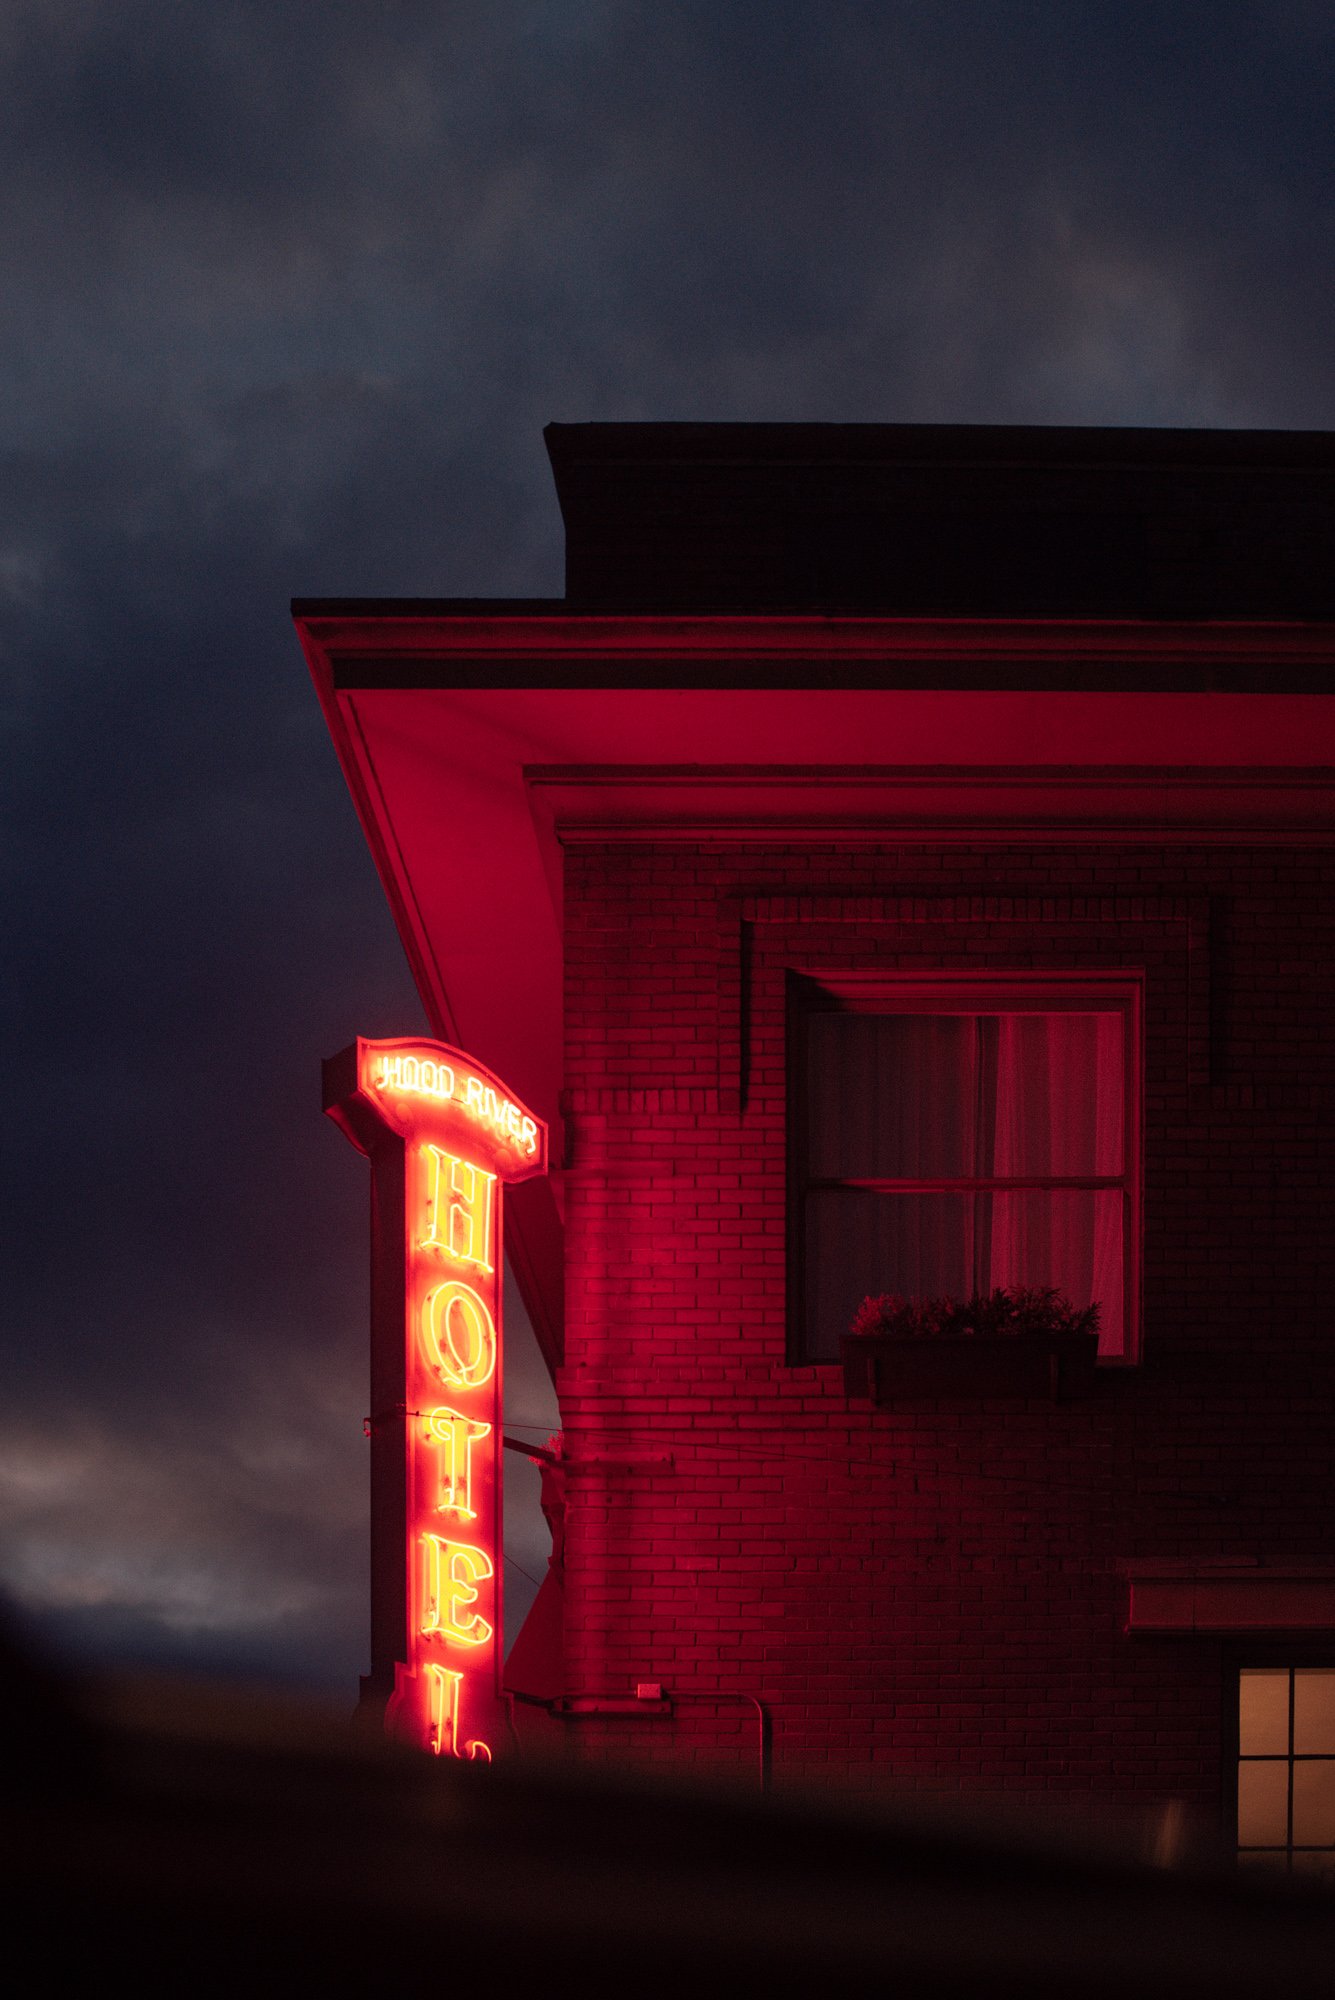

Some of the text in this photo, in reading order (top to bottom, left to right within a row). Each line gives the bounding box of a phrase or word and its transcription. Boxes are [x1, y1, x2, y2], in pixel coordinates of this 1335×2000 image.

[375, 1055, 537, 1154] HOOD RIVER
[420, 1144, 496, 1763] HOTEL
